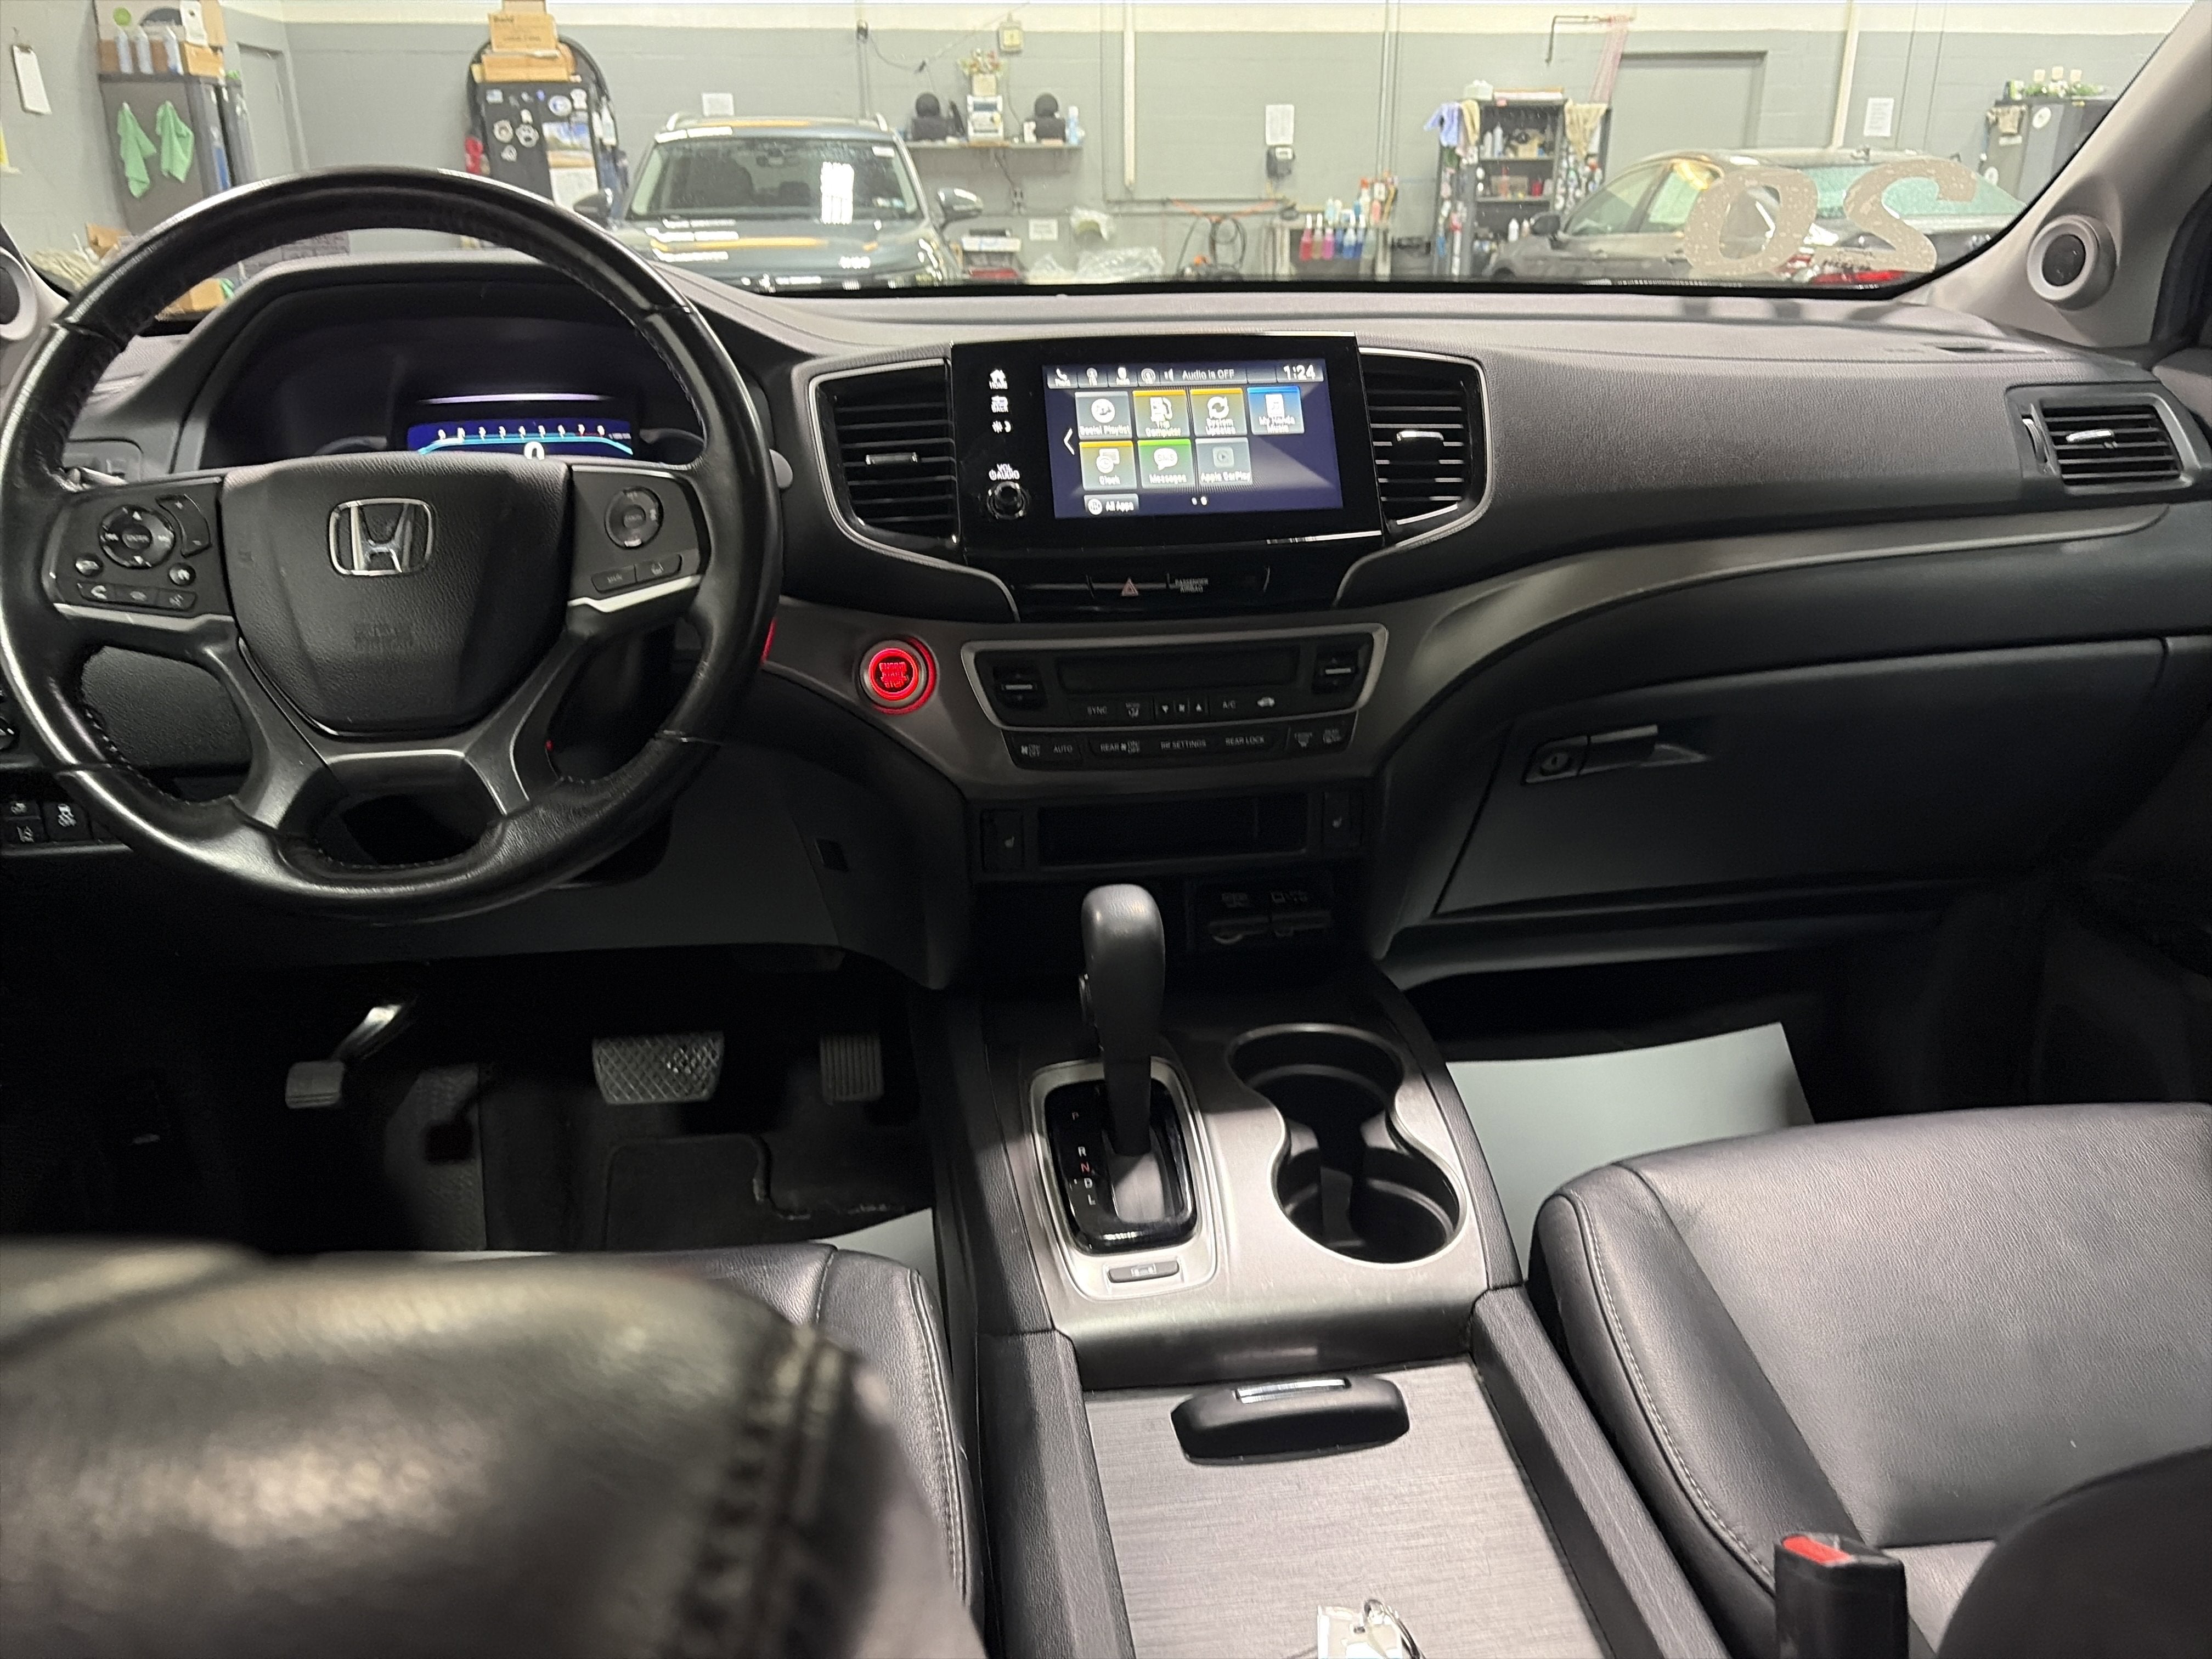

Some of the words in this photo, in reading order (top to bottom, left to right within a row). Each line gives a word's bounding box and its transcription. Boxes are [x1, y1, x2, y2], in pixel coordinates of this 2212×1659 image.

[1182, 368, 1206, 381] Audio
[1217, 369, 1235, 380] OFF
[1284, 365, 1316, 381] 1:24
[1156, 453, 1175, 462] SMS
[1105, 501, 1115, 511] All
[1116, 501, 1135, 512] Apps
[1222, 700, 1236, 709] A/C
[1087, 706, 1108, 715] SYNC
[1245, 735, 1265, 745] LOCK
[1053, 744, 1073, 754] AUTO
[1071, 1111, 1079, 1120] P
[1078, 1146, 1087, 1156] R
[1081, 1162, 1090, 1173] N
[1084, 1178, 1093, 1189] D
[1087, 1194, 1096, 1205] L
